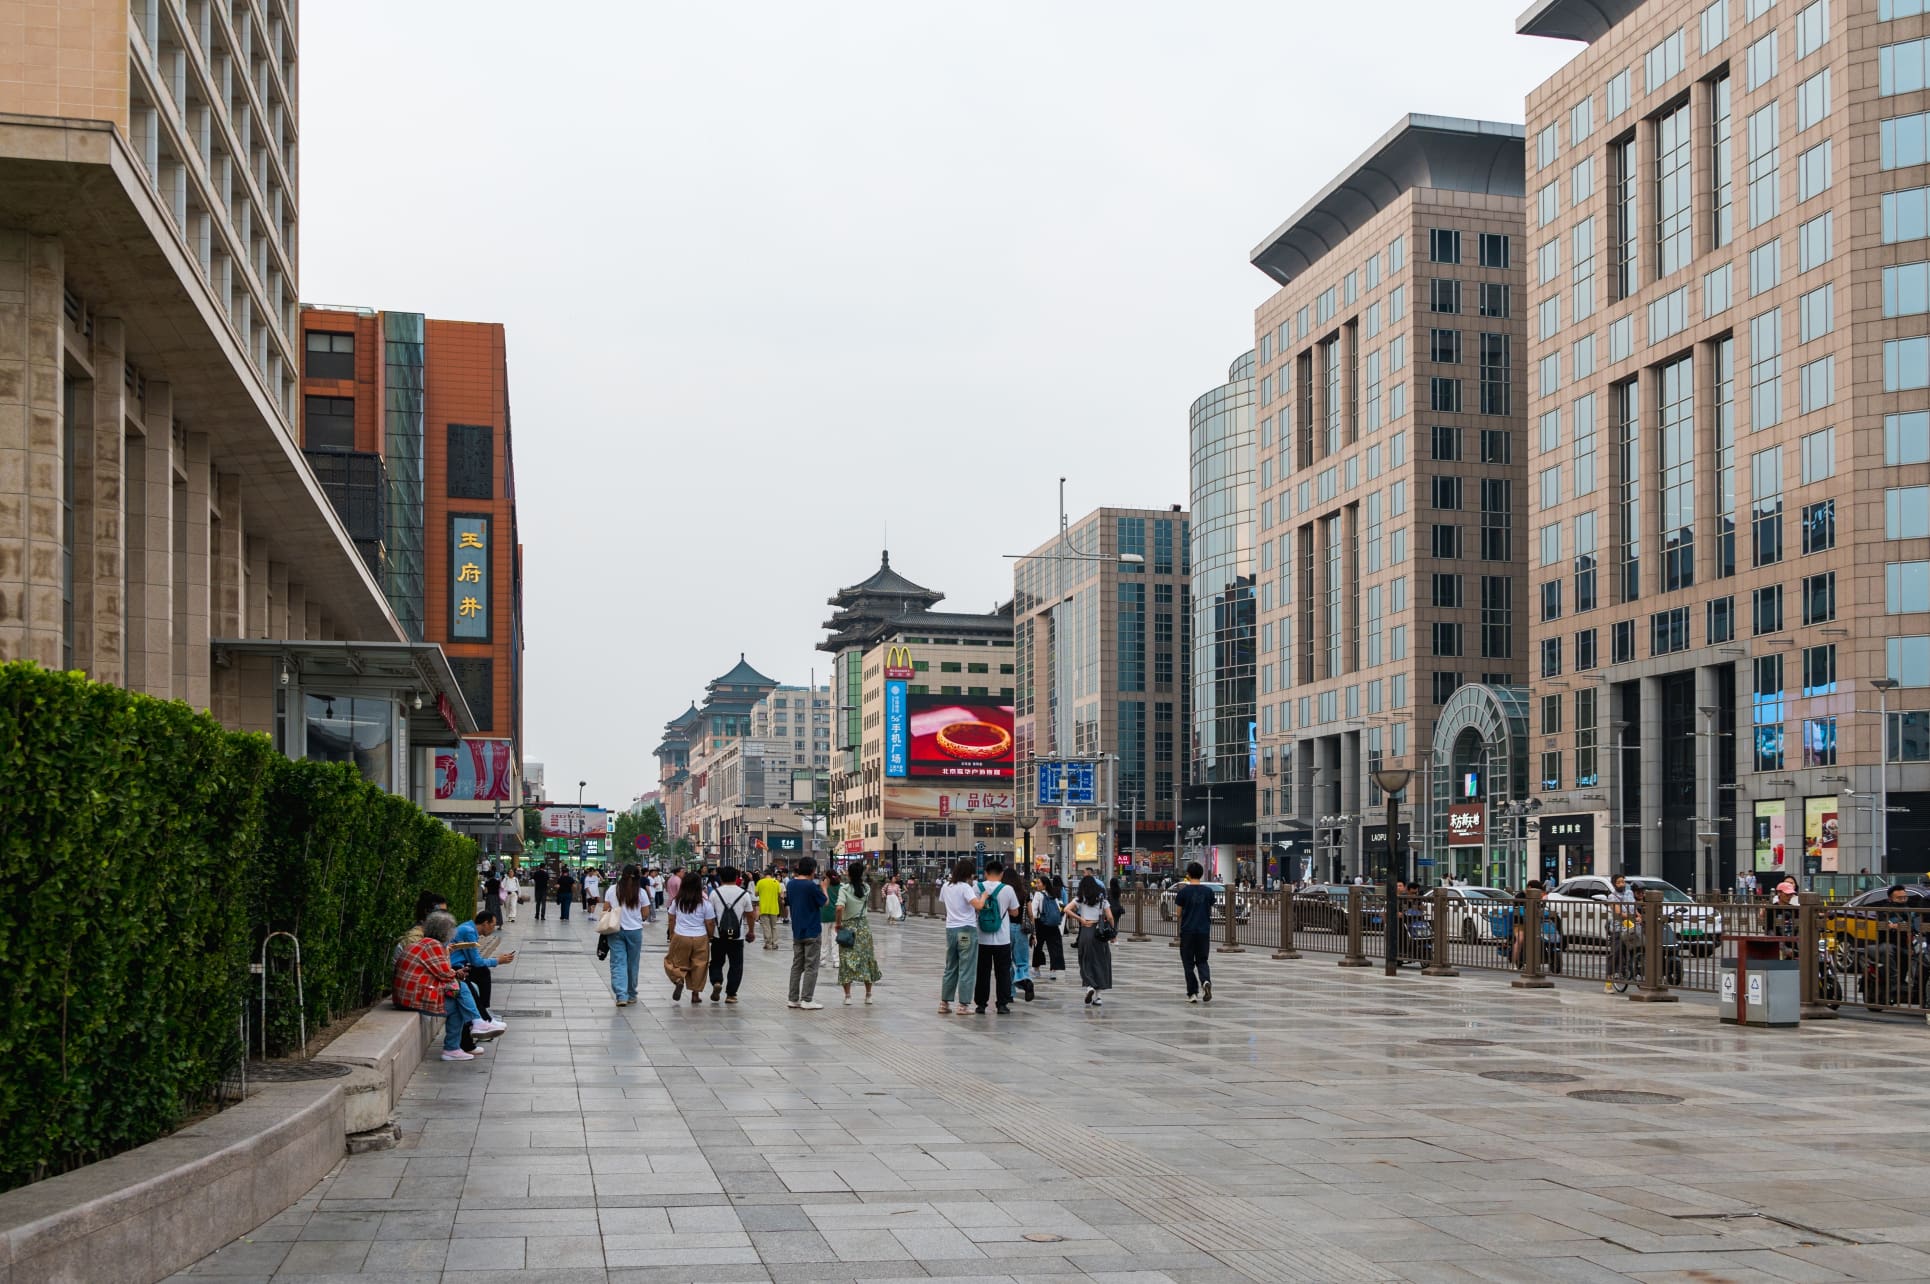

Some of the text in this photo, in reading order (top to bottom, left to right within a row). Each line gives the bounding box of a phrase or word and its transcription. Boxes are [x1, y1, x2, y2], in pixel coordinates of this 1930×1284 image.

[457, 531, 484, 619] 王府井
[967, 792, 1015, 809] 品位之
[1450, 812, 1480, 829] 东方新天地
